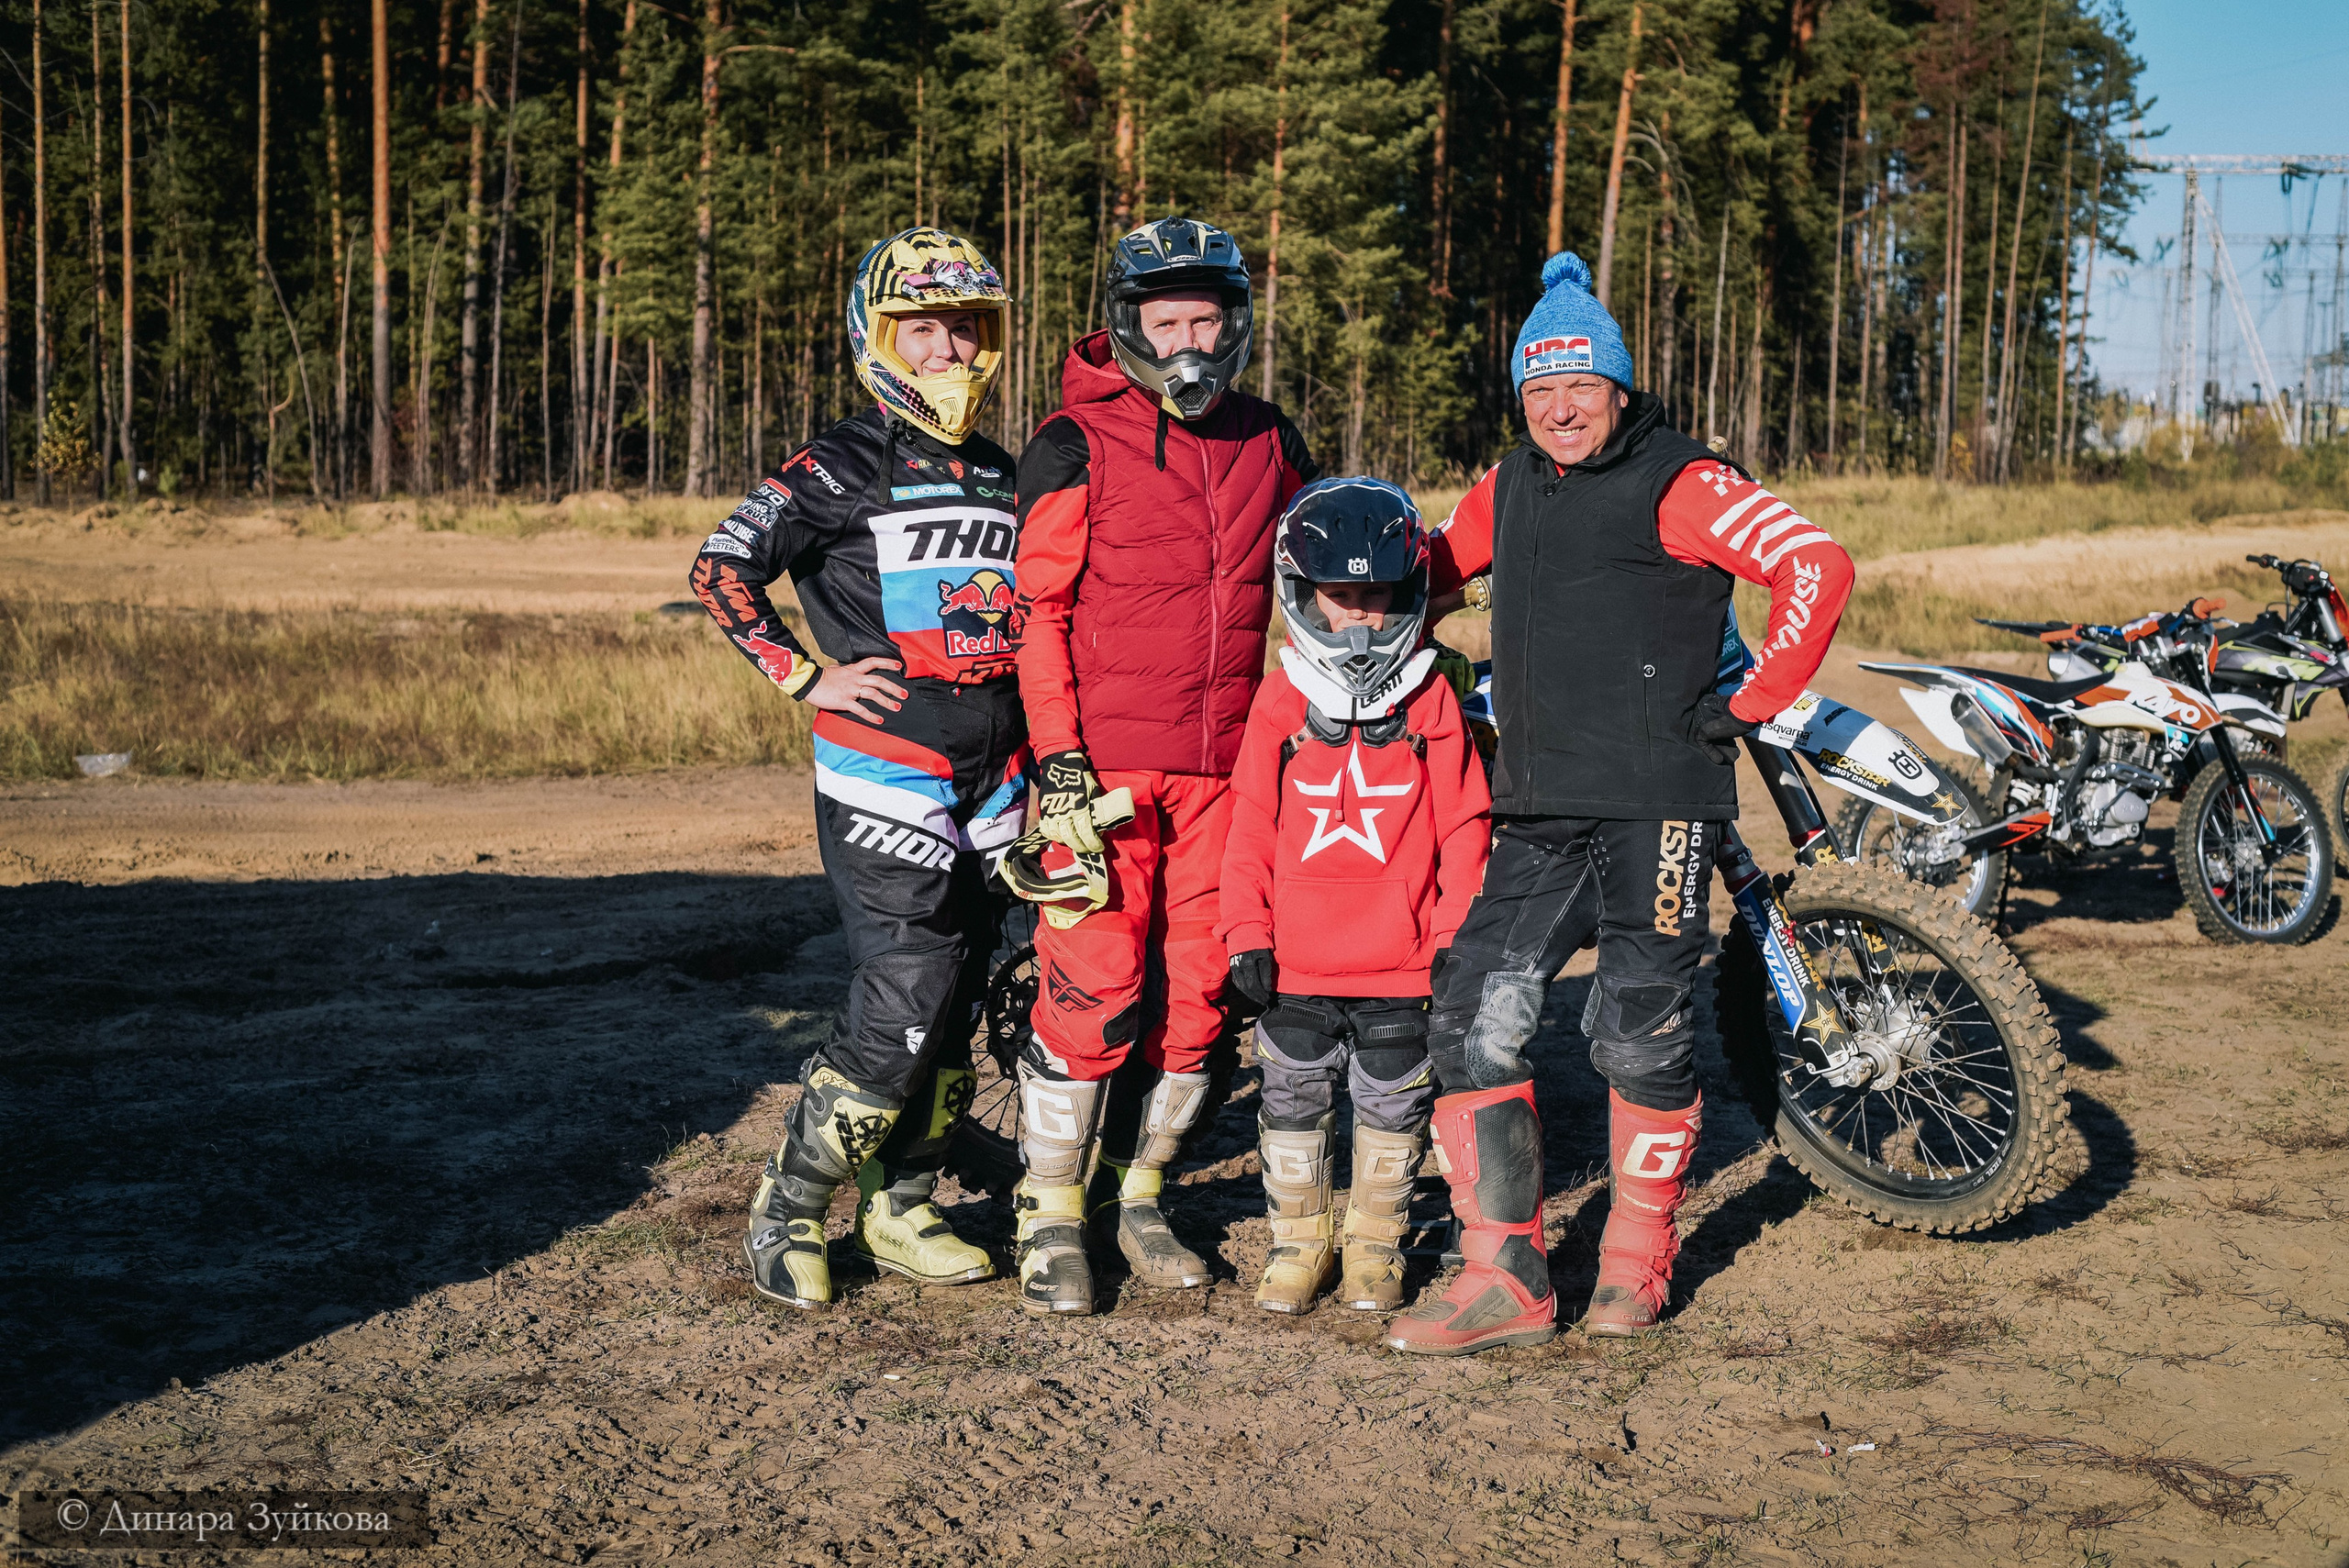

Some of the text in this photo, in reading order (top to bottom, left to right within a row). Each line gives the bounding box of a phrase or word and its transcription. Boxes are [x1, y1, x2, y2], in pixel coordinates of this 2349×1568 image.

[1524, 338, 1590, 369] HRC
[1525, 364, 1553, 376] HONDA
[800, 455, 846, 495] XTRIG
[912, 485, 963, 496] MOTOREX
[903, 518, 1017, 562] THO
[946, 627, 996, 656] Red
[1360, 669, 1404, 709] LEATT
[2123, 690, 2201, 725] KAYO
[1760, 721, 1810, 741] usqvarna
[1818, 748, 1892, 788] ROCKSTAR
[1820, 762, 1879, 792] ENERGY DRINK
[1040, 792, 1085, 815] FOX
[843, 813, 956, 873] THOR
[1654, 819, 1688, 937] ROCKST
[1683, 851, 1700, 918] ENERGY
[1738, 903, 1801, 1007] DUNLOP
[1785, 947, 1811, 989] DRINK
[1985, 1156, 2003, 1177] EXCEL
